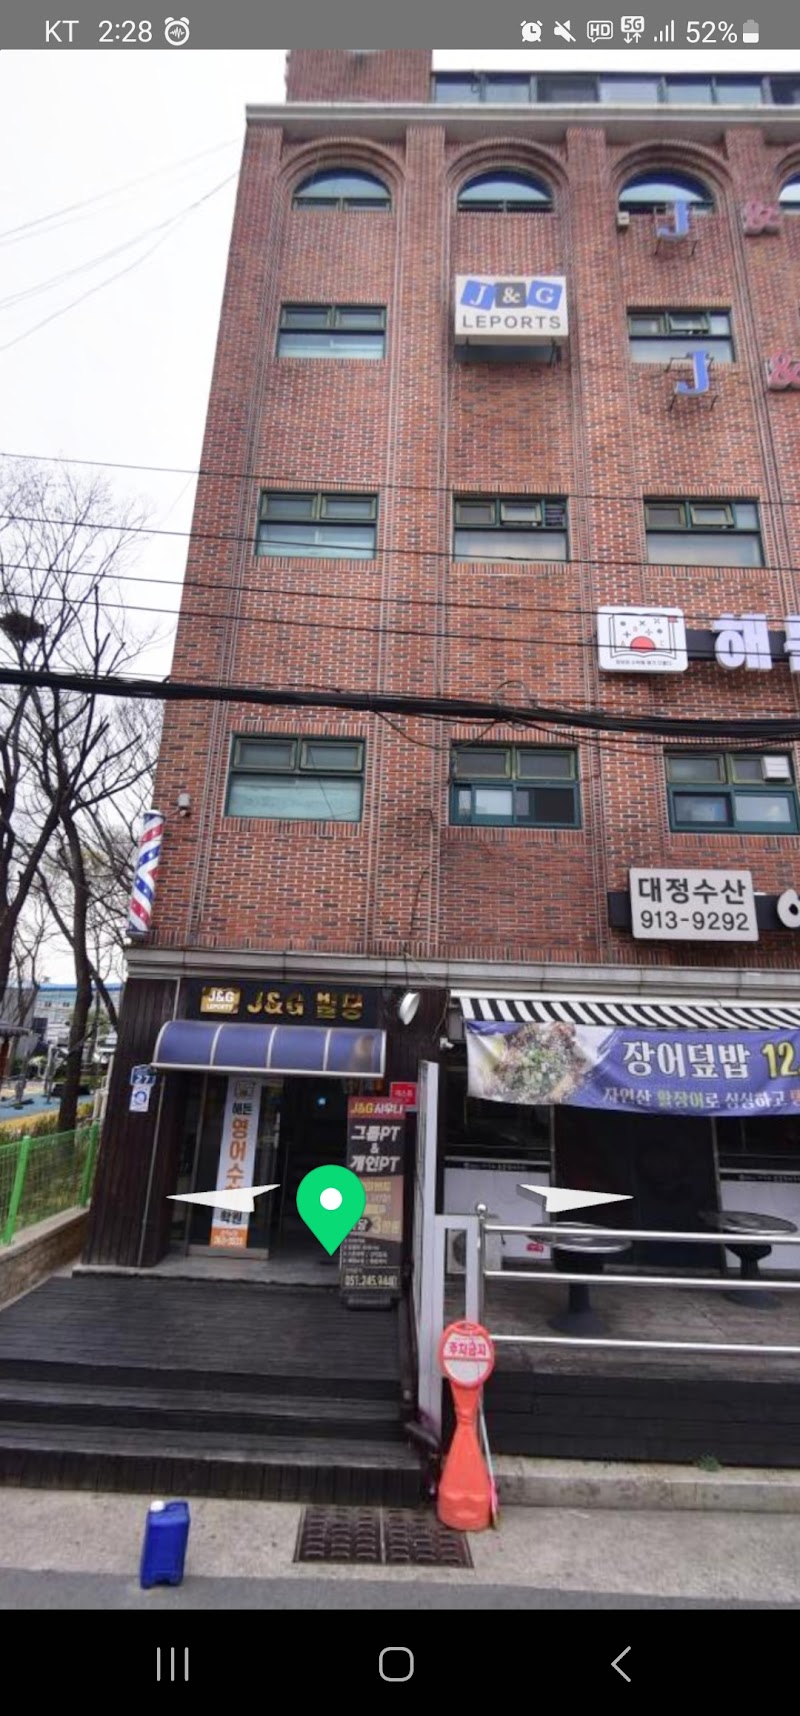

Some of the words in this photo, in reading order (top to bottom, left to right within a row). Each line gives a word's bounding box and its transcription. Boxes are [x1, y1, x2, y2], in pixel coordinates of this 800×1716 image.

[462, 314, 562, 330] LEPORTS
[638, 877, 746, 905] 대정수산
[640, 910, 749, 931] 913-9292
[207, 990, 234, 1003] J&G
[247, 991, 304, 1016] J&G
[316, 991, 363, 1020] 빌딩
[622, 1040, 751, 1079] 장어덮밥
[350, 1125, 401, 1142] 그룹PT
[370, 1142, 379, 1154] &
[350, 1155, 401, 1172] 개인PT
